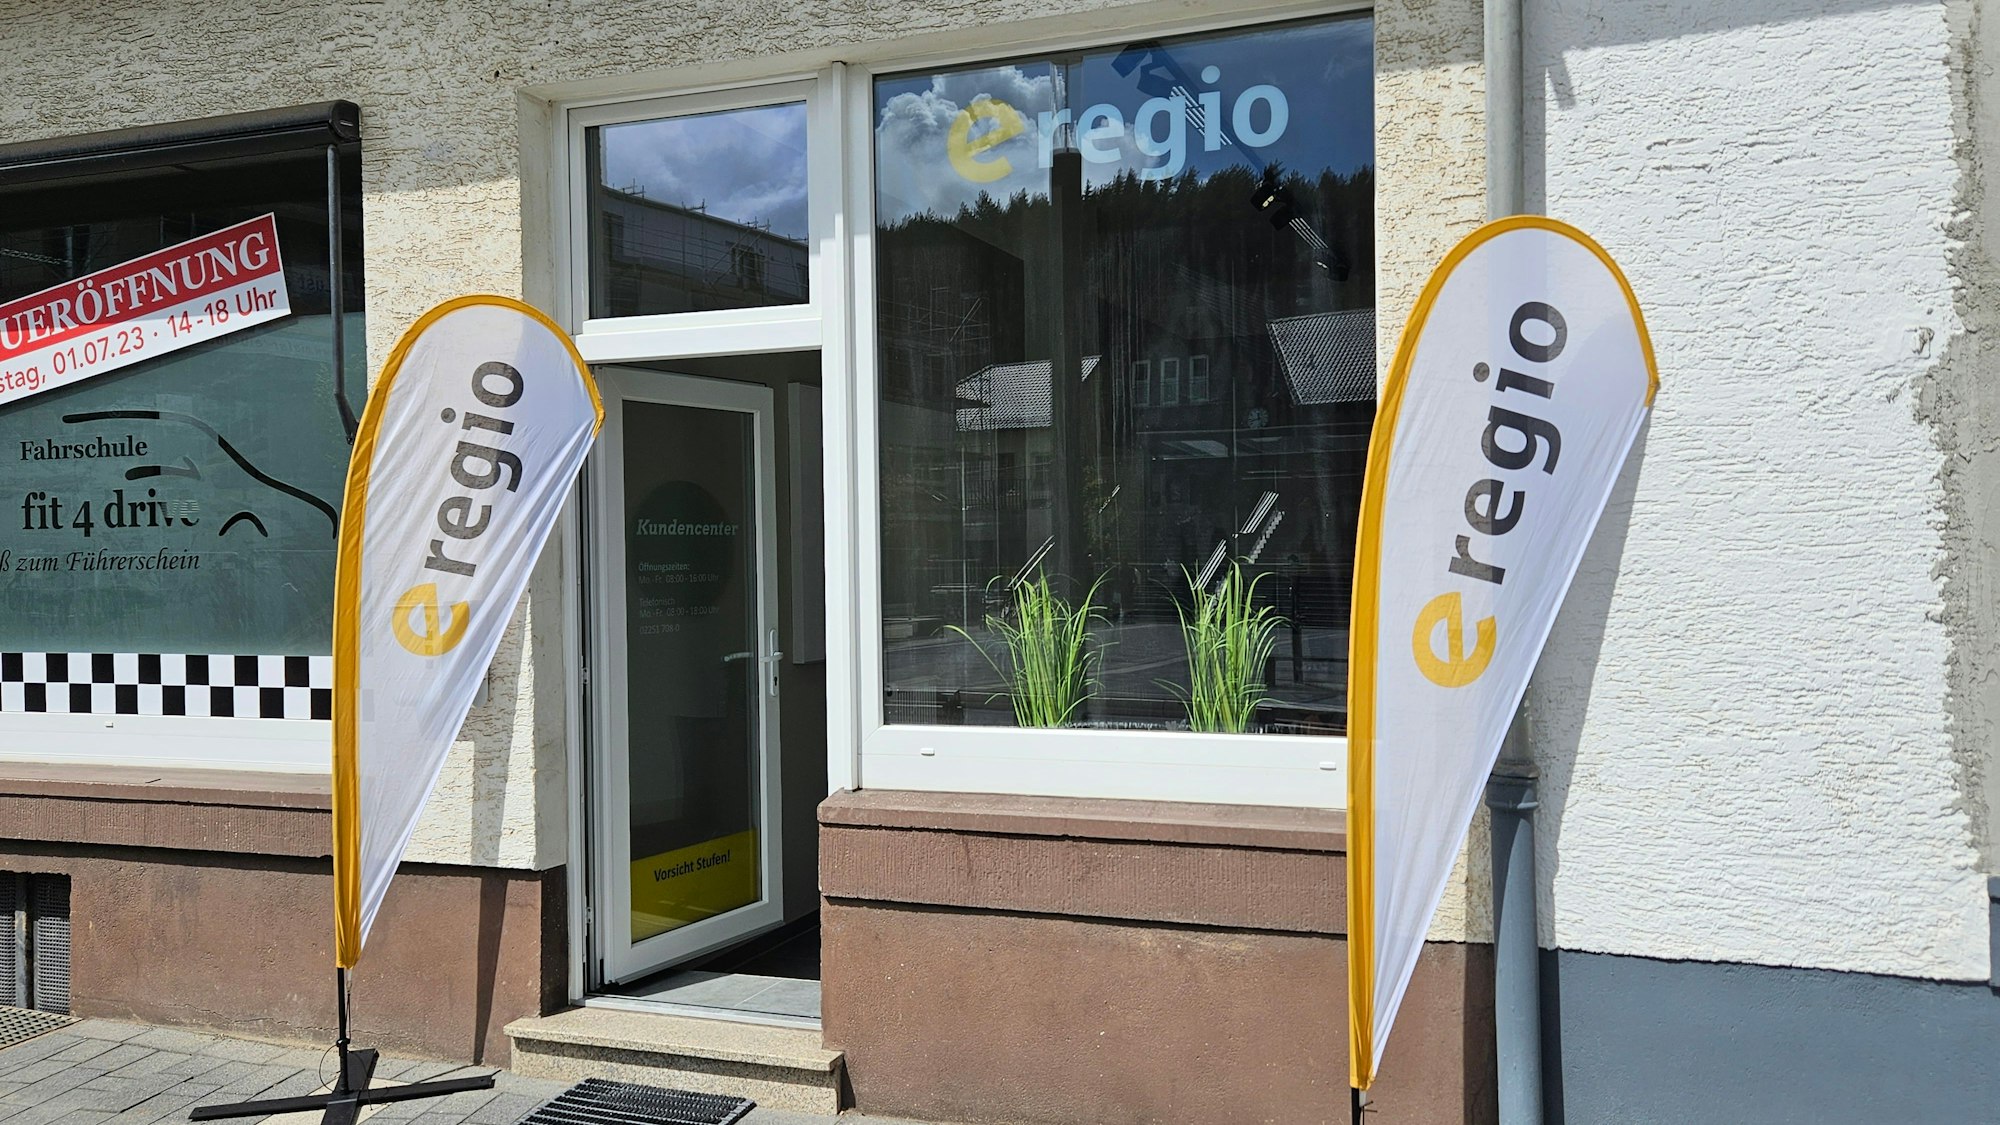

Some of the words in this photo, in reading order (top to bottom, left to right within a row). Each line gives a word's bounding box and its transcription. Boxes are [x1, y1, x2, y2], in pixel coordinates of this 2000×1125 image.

[0, 231, 271, 350] UERÖFFNUNG
[53, 326, 145, 375] 01.07.23
[235, 286, 277, 317] Uhr
[20, 435, 148, 461] Fahrschule
[21, 491, 64, 530] fit
[72, 500, 95, 538] 4
[103, 488, 200, 528] drive
[636, 518, 739, 536] Kundencenter
[15, 555, 60, 572] zum
[66, 547, 201, 572] Führerschein
[654, 860, 694, 882] Vorsicht
[696, 849, 731, 871] Stufen!
